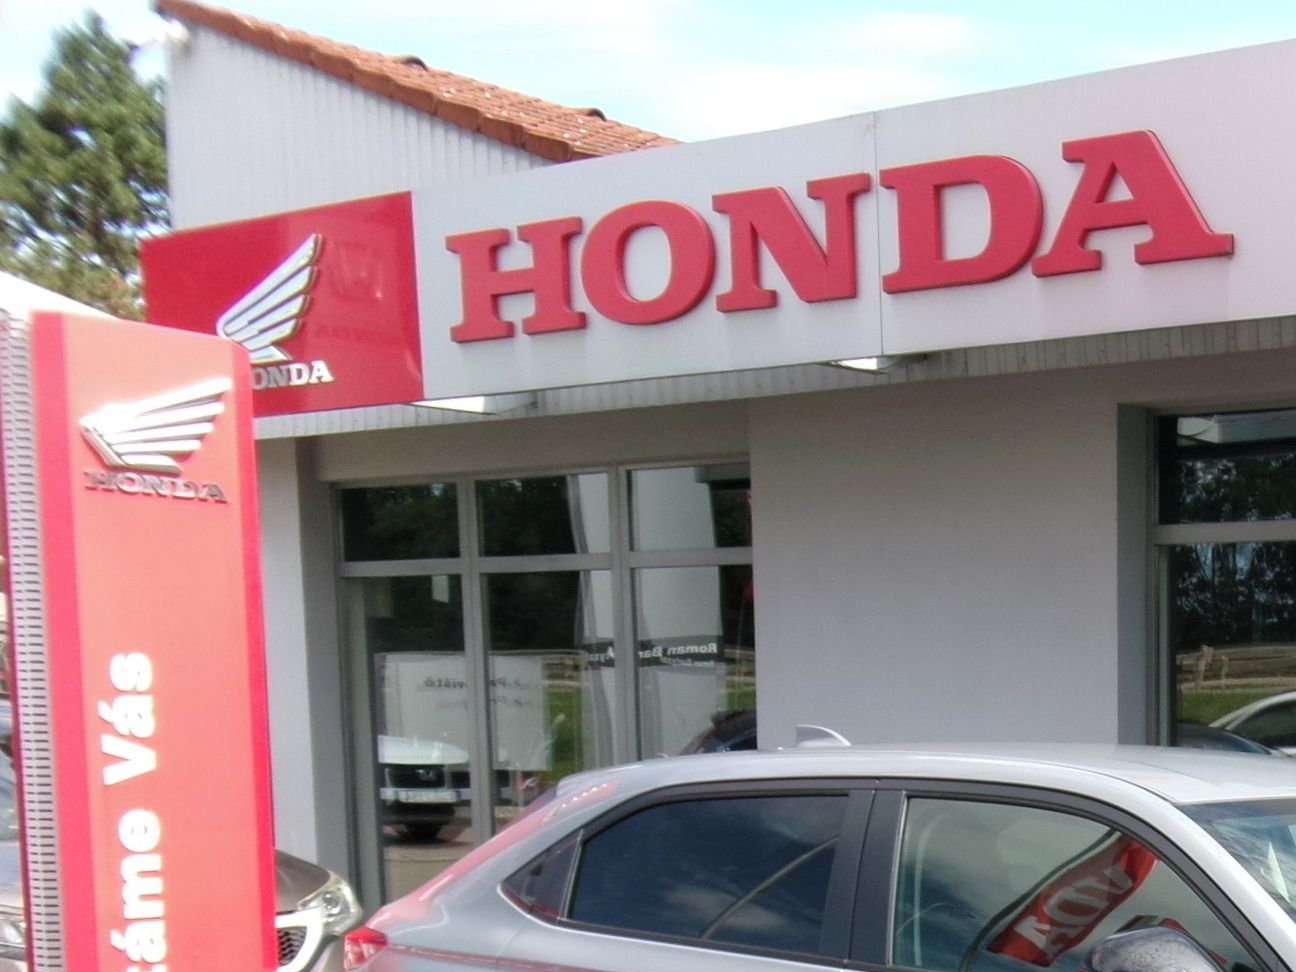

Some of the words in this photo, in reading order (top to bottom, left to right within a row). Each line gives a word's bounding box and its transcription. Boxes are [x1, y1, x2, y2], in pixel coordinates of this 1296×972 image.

[445, 129, 1235, 343] HONDA
[251, 360, 335, 390] ONDA
[84, 469, 228, 504] HONDA
[98, 651, 157, 786] Vás
